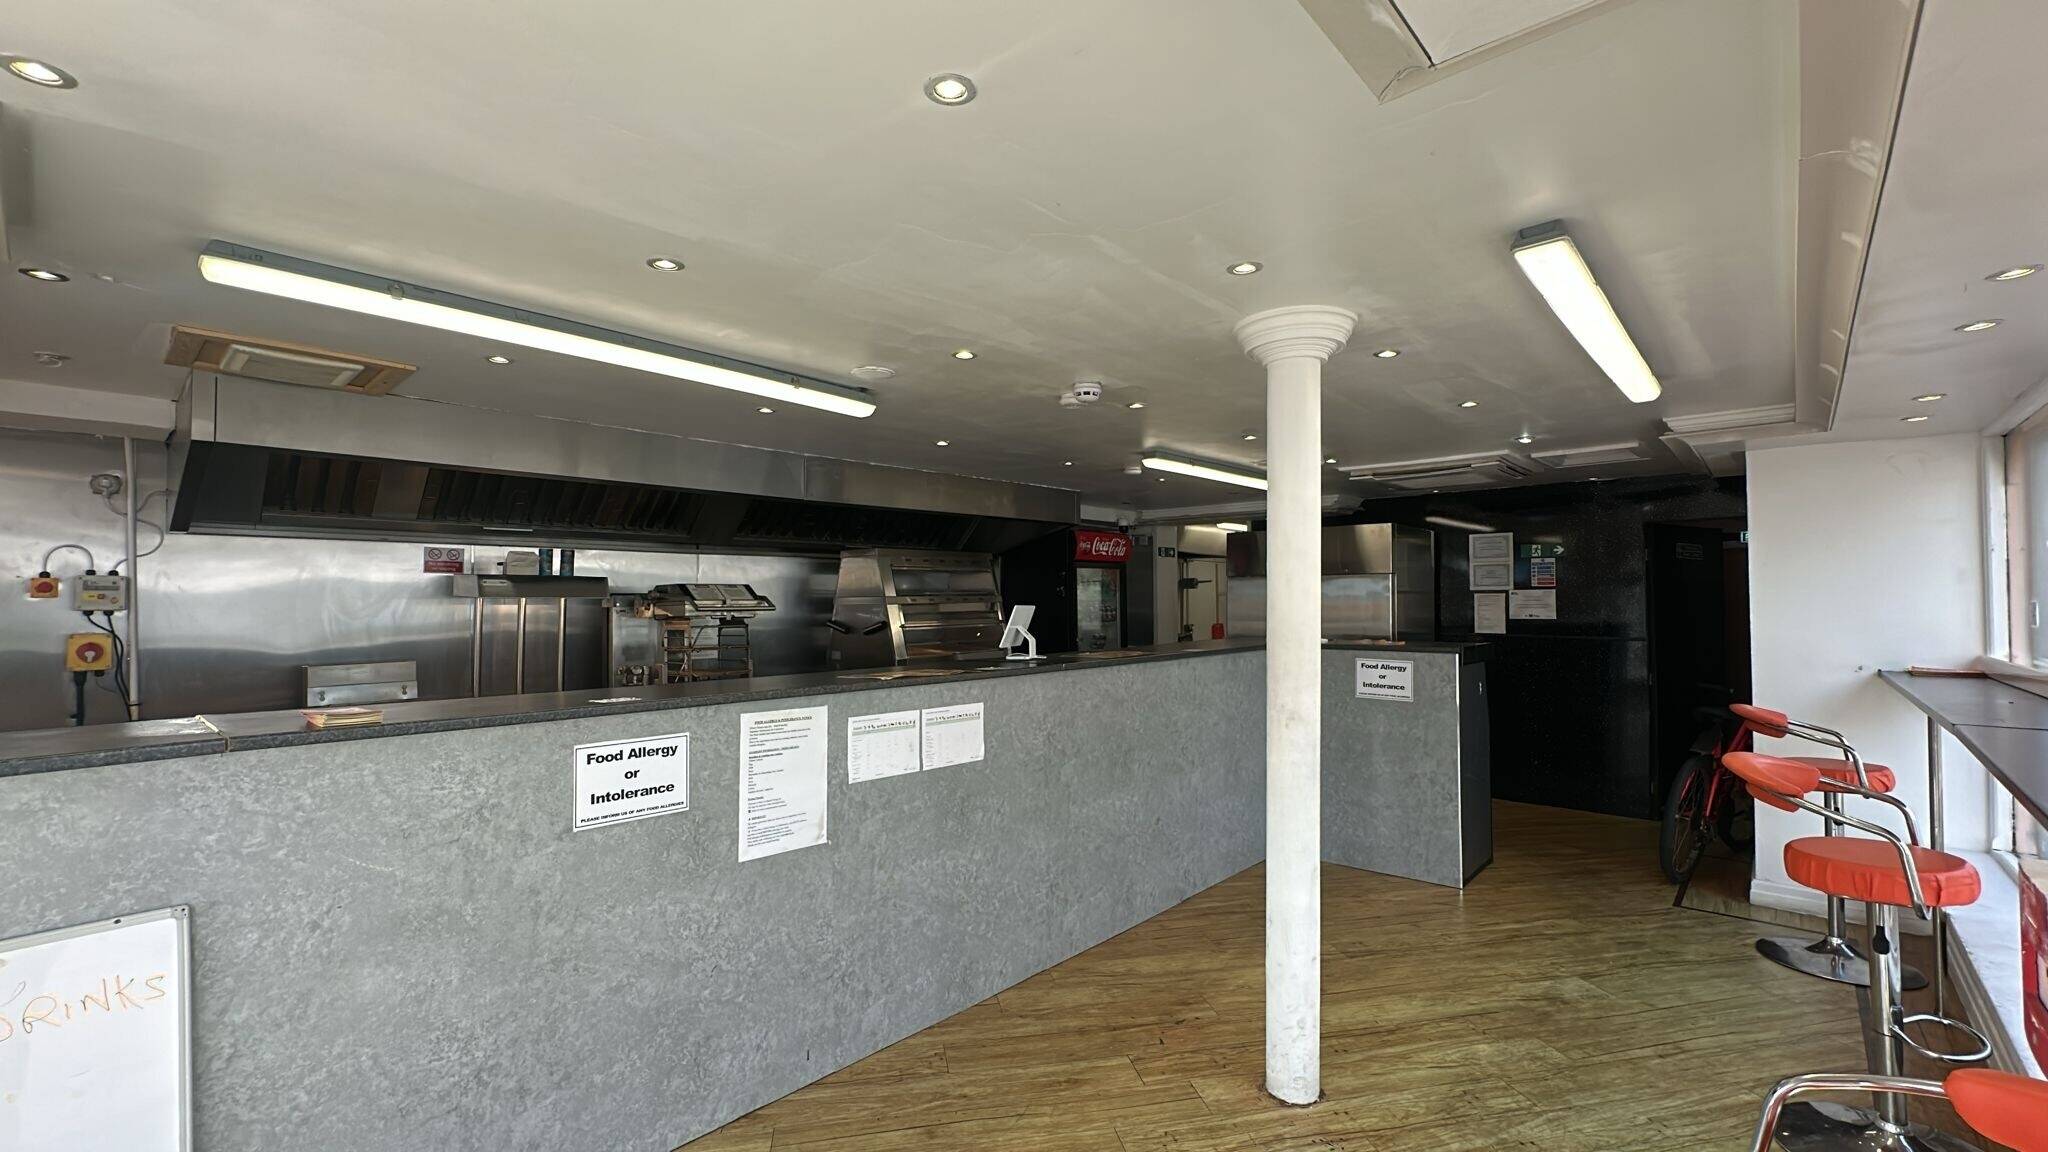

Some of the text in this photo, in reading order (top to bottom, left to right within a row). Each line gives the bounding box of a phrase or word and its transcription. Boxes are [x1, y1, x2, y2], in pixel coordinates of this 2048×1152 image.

[1380, 664, 1407, 672] Allergy
[1363, 682, 1405, 690] Intolerance
[586, 745, 679, 765] Food Allergy
[624, 769, 640, 780] or
[590, 783, 675, 805] Intolerance
